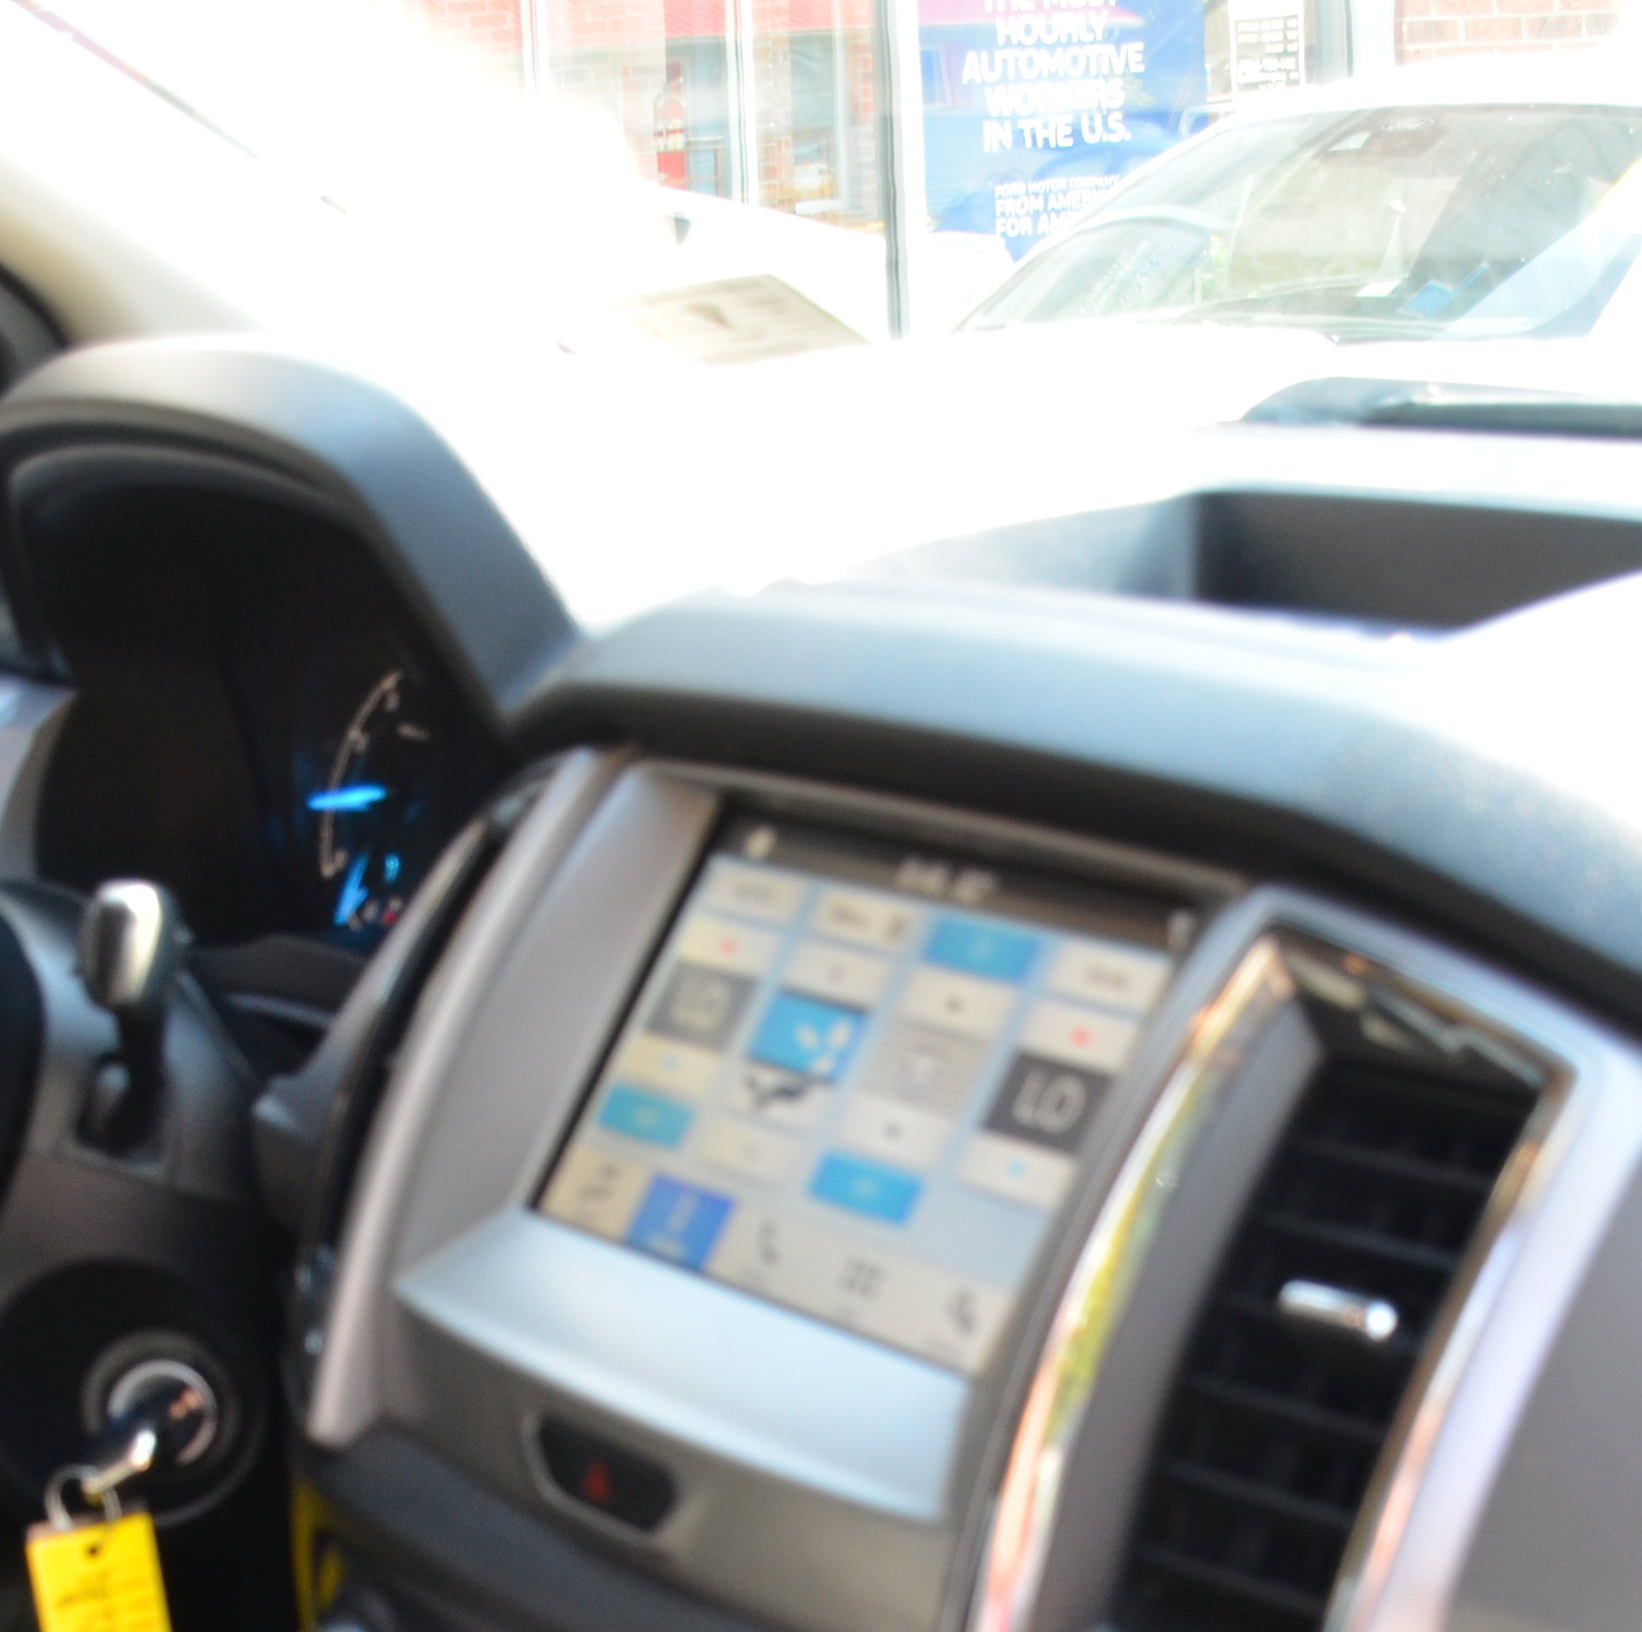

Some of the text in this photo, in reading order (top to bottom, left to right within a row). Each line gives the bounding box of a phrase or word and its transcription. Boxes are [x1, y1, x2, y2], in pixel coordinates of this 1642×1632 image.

[996, 11, 1108, 45] HOURLY
[961, 42, 1145, 84] AUTOMOTIVE
[984, 78, 1125, 117] WORKERS
[982, 111, 1132, 152] IN THE U.S.
[994, 173, 1120, 198] FORD MOTOR COMPANY
[995, 194, 1043, 216] FROM
[995, 215, 1033, 237] FOR
